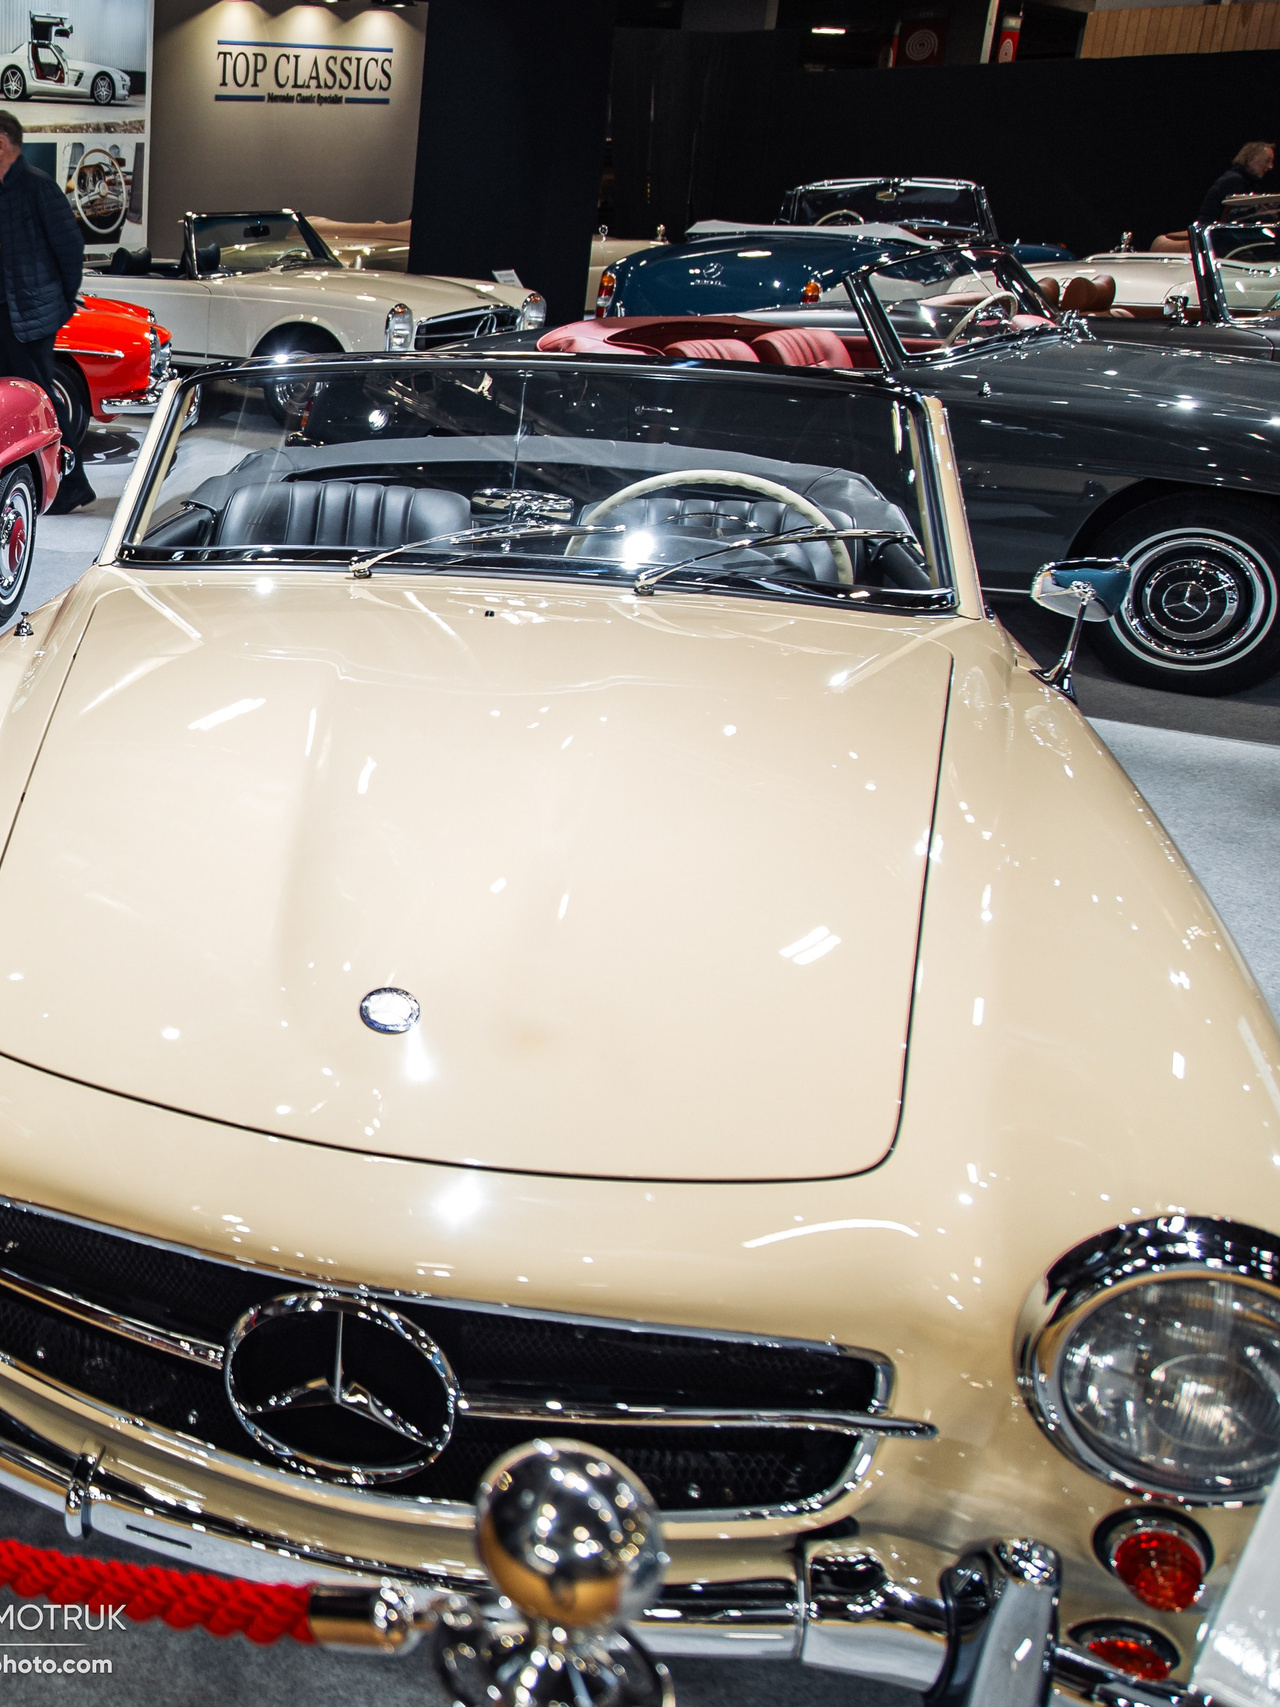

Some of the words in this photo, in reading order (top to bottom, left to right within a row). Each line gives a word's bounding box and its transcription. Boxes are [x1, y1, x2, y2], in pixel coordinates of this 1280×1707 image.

[217, 51, 268, 88] TOP
[274, 53, 393, 91] CLASSICS
[267, 92, 295, 103] Mercedes
[296, 93, 316, 104] Classic
